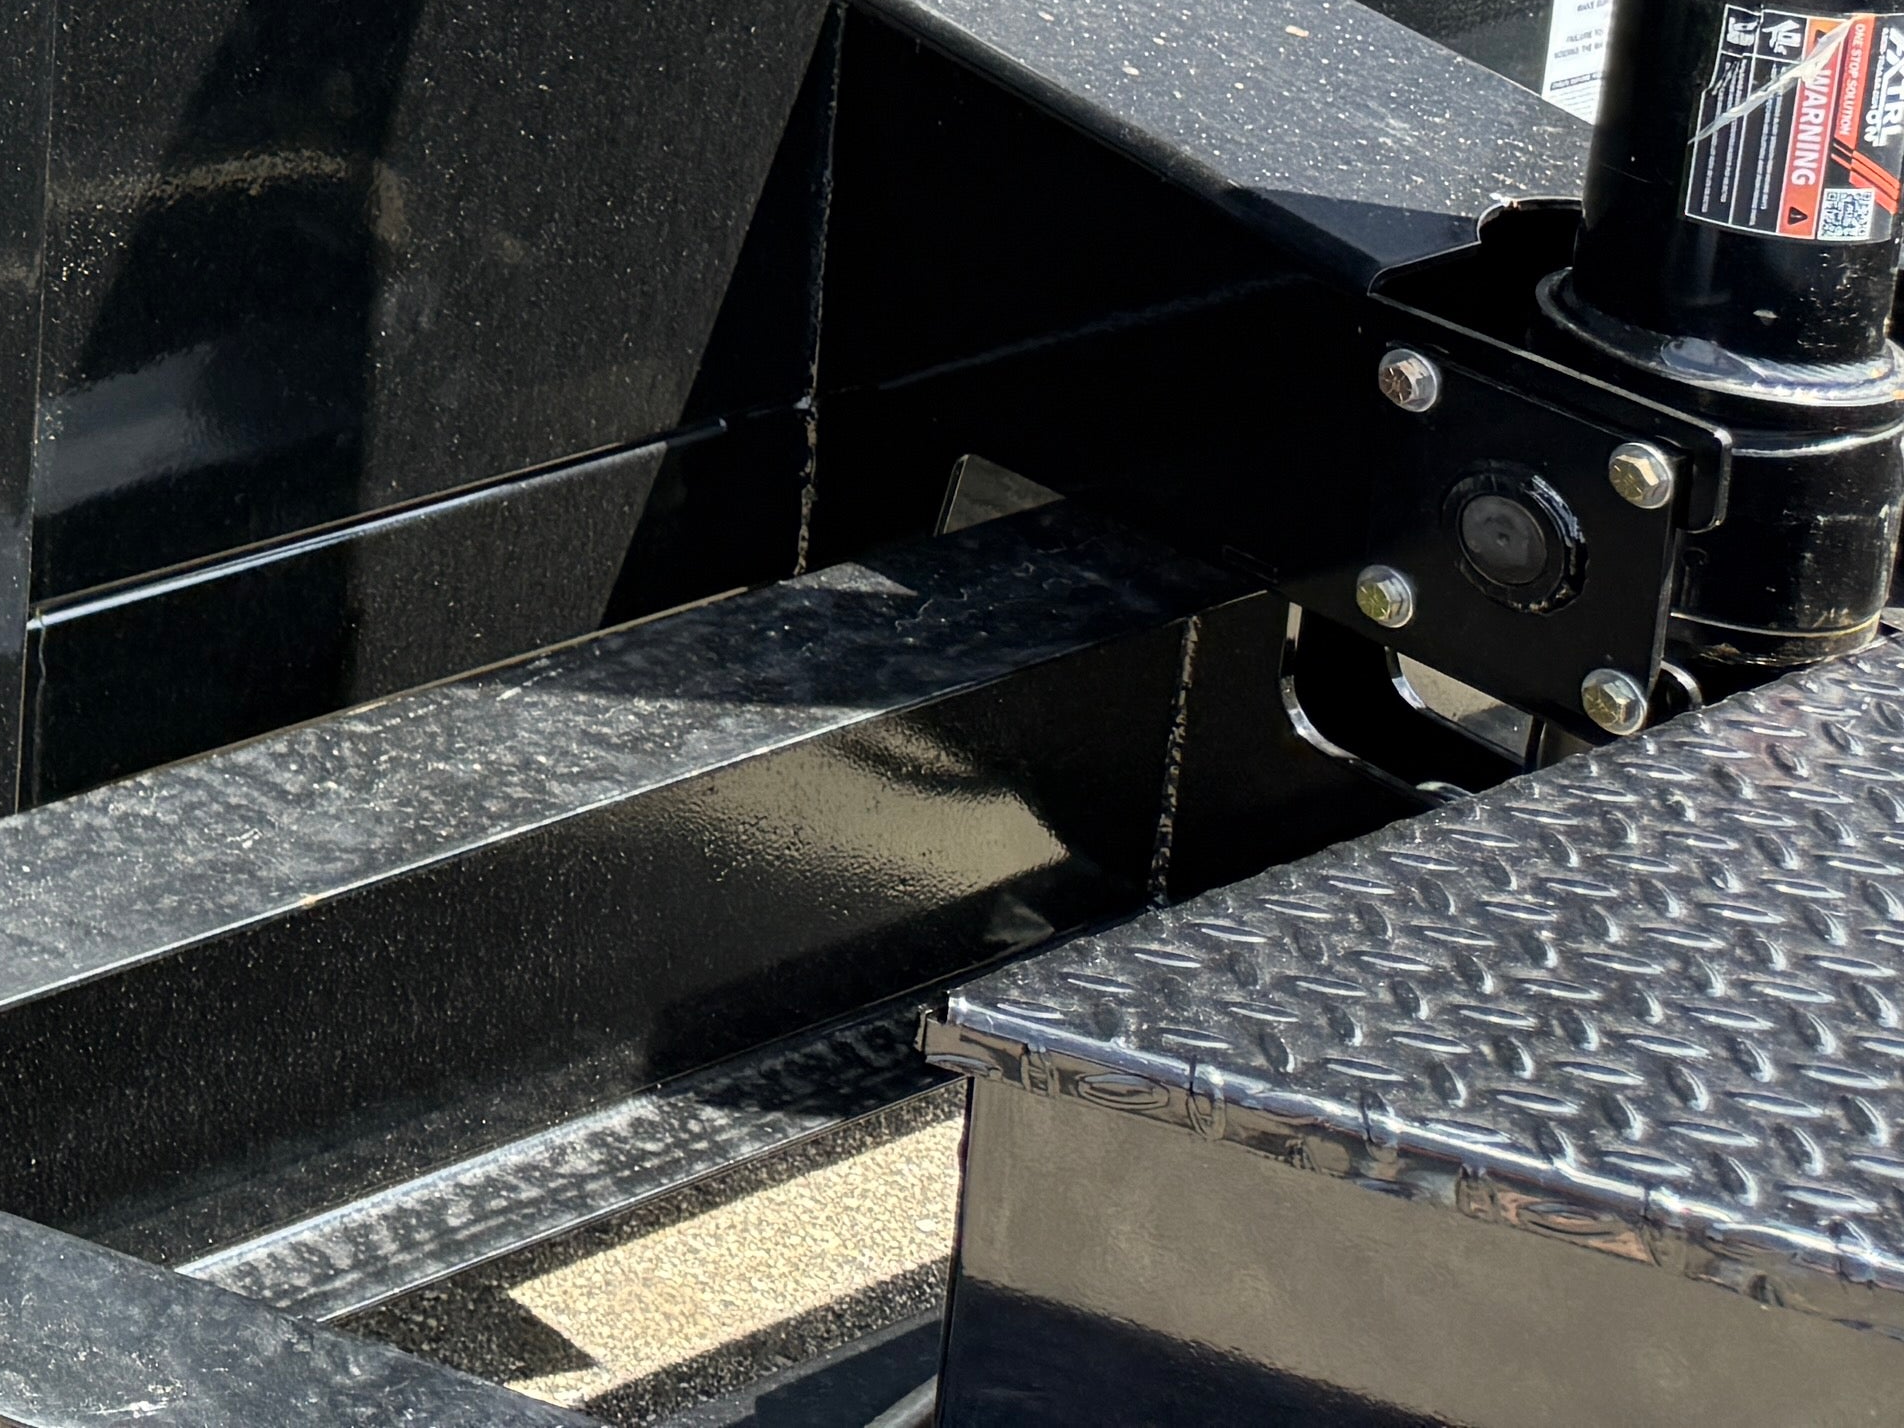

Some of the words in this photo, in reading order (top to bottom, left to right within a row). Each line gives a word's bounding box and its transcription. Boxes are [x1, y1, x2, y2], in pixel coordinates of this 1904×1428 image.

[1854, 23, 1866, 48] ONE
[1849, 48, 1863, 78] STOP
[1791, 69, 1832, 186] WARNING
[1840, 78, 1858, 136] SOLUTION
